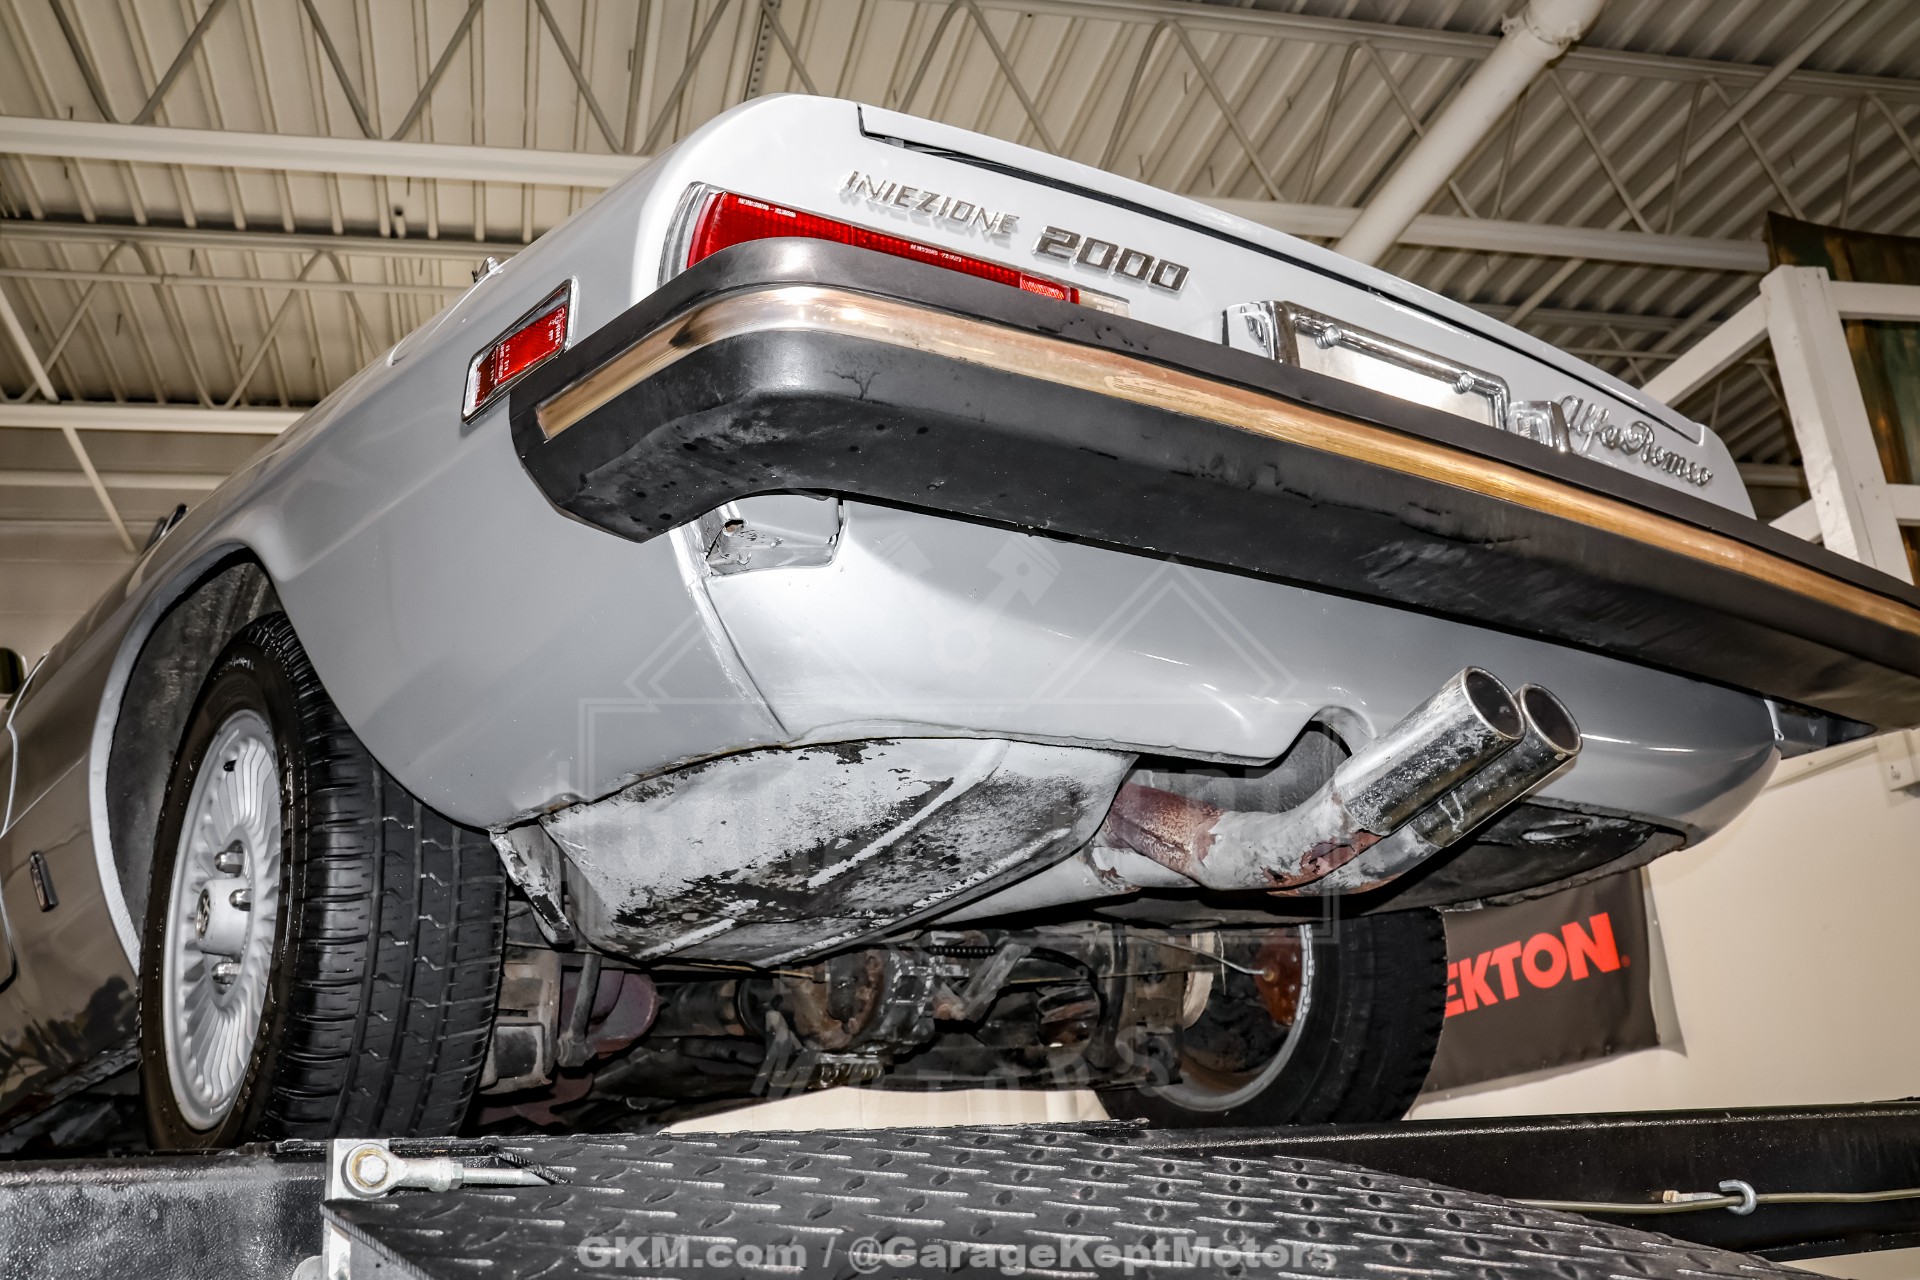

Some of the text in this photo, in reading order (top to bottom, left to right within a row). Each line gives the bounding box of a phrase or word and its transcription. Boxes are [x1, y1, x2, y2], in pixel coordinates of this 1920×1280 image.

[843, 170, 1190, 292] INIEZIONE 2000
[1623, 420, 1713, 487] Romeo
